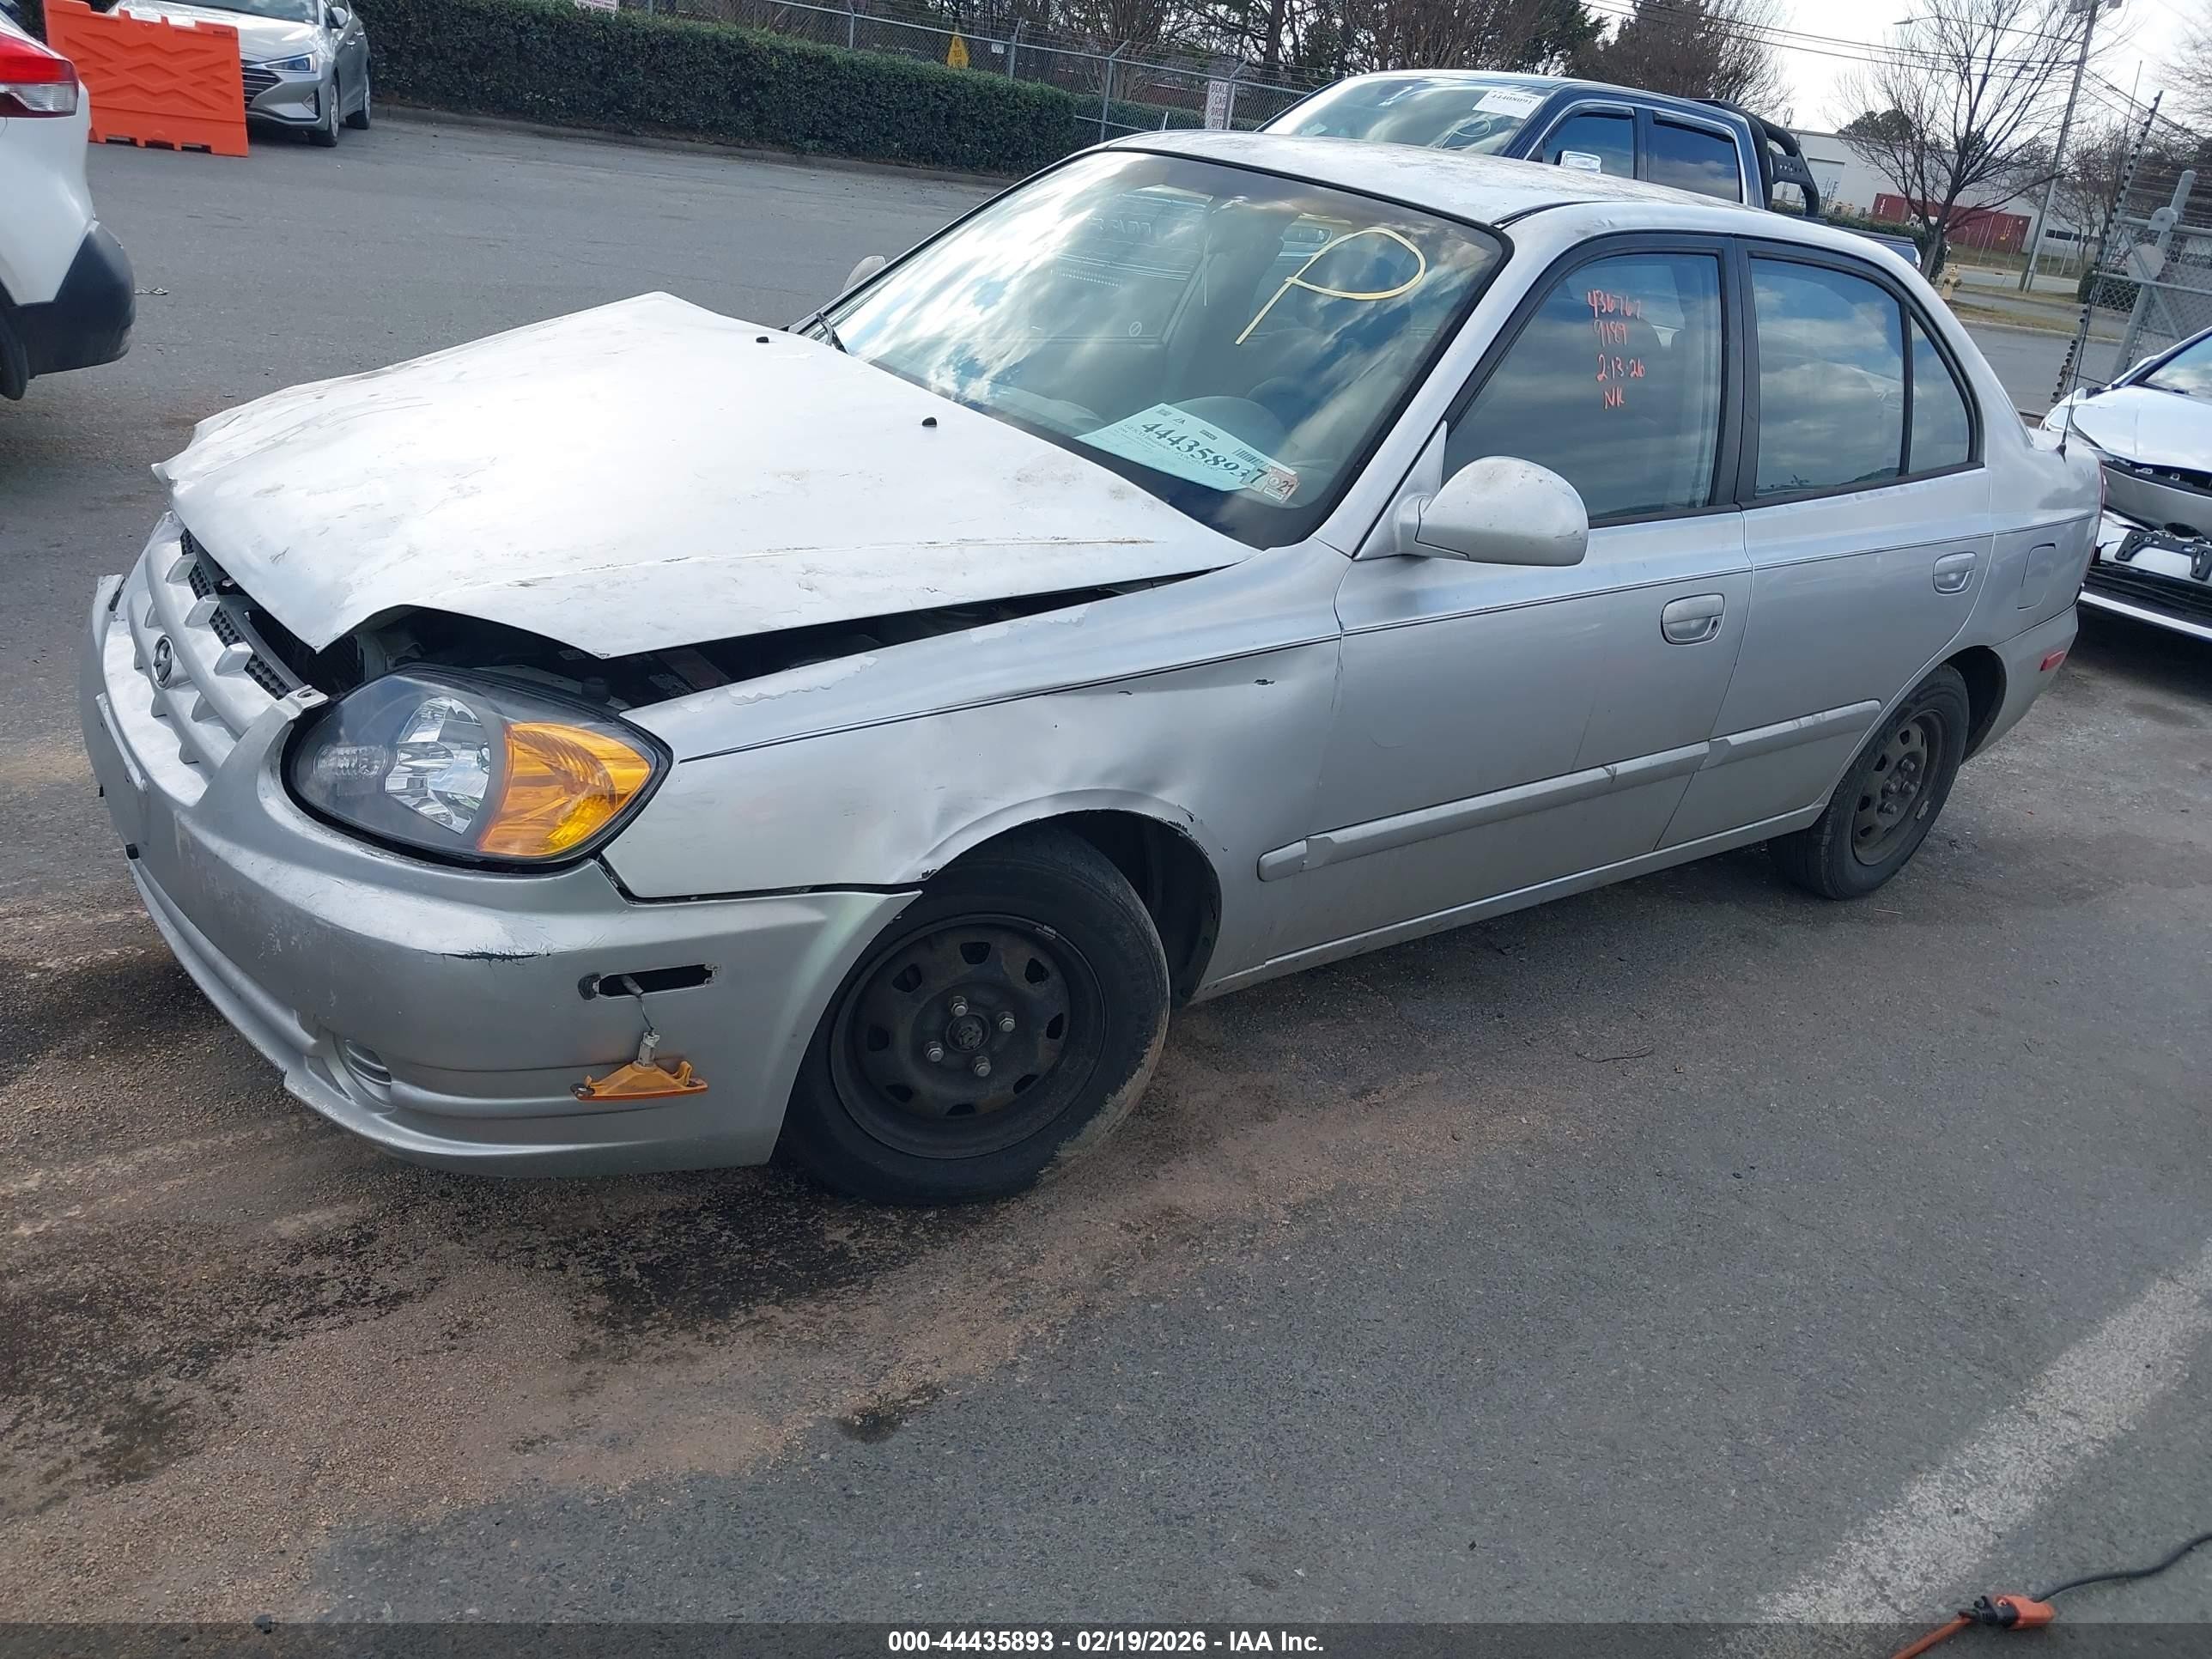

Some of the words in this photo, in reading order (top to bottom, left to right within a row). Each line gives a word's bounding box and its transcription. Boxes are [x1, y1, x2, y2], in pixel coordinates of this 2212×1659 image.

[1211, 82, 1230, 94] DEALE
[1235, 226, 1426, 346] P
[1594, 319, 1628, 348] 9189
[1141, 422, 1250, 477] 44435893
[1250, 467, 1268, 483] 7
[1277, 480, 1294, 495] 21
